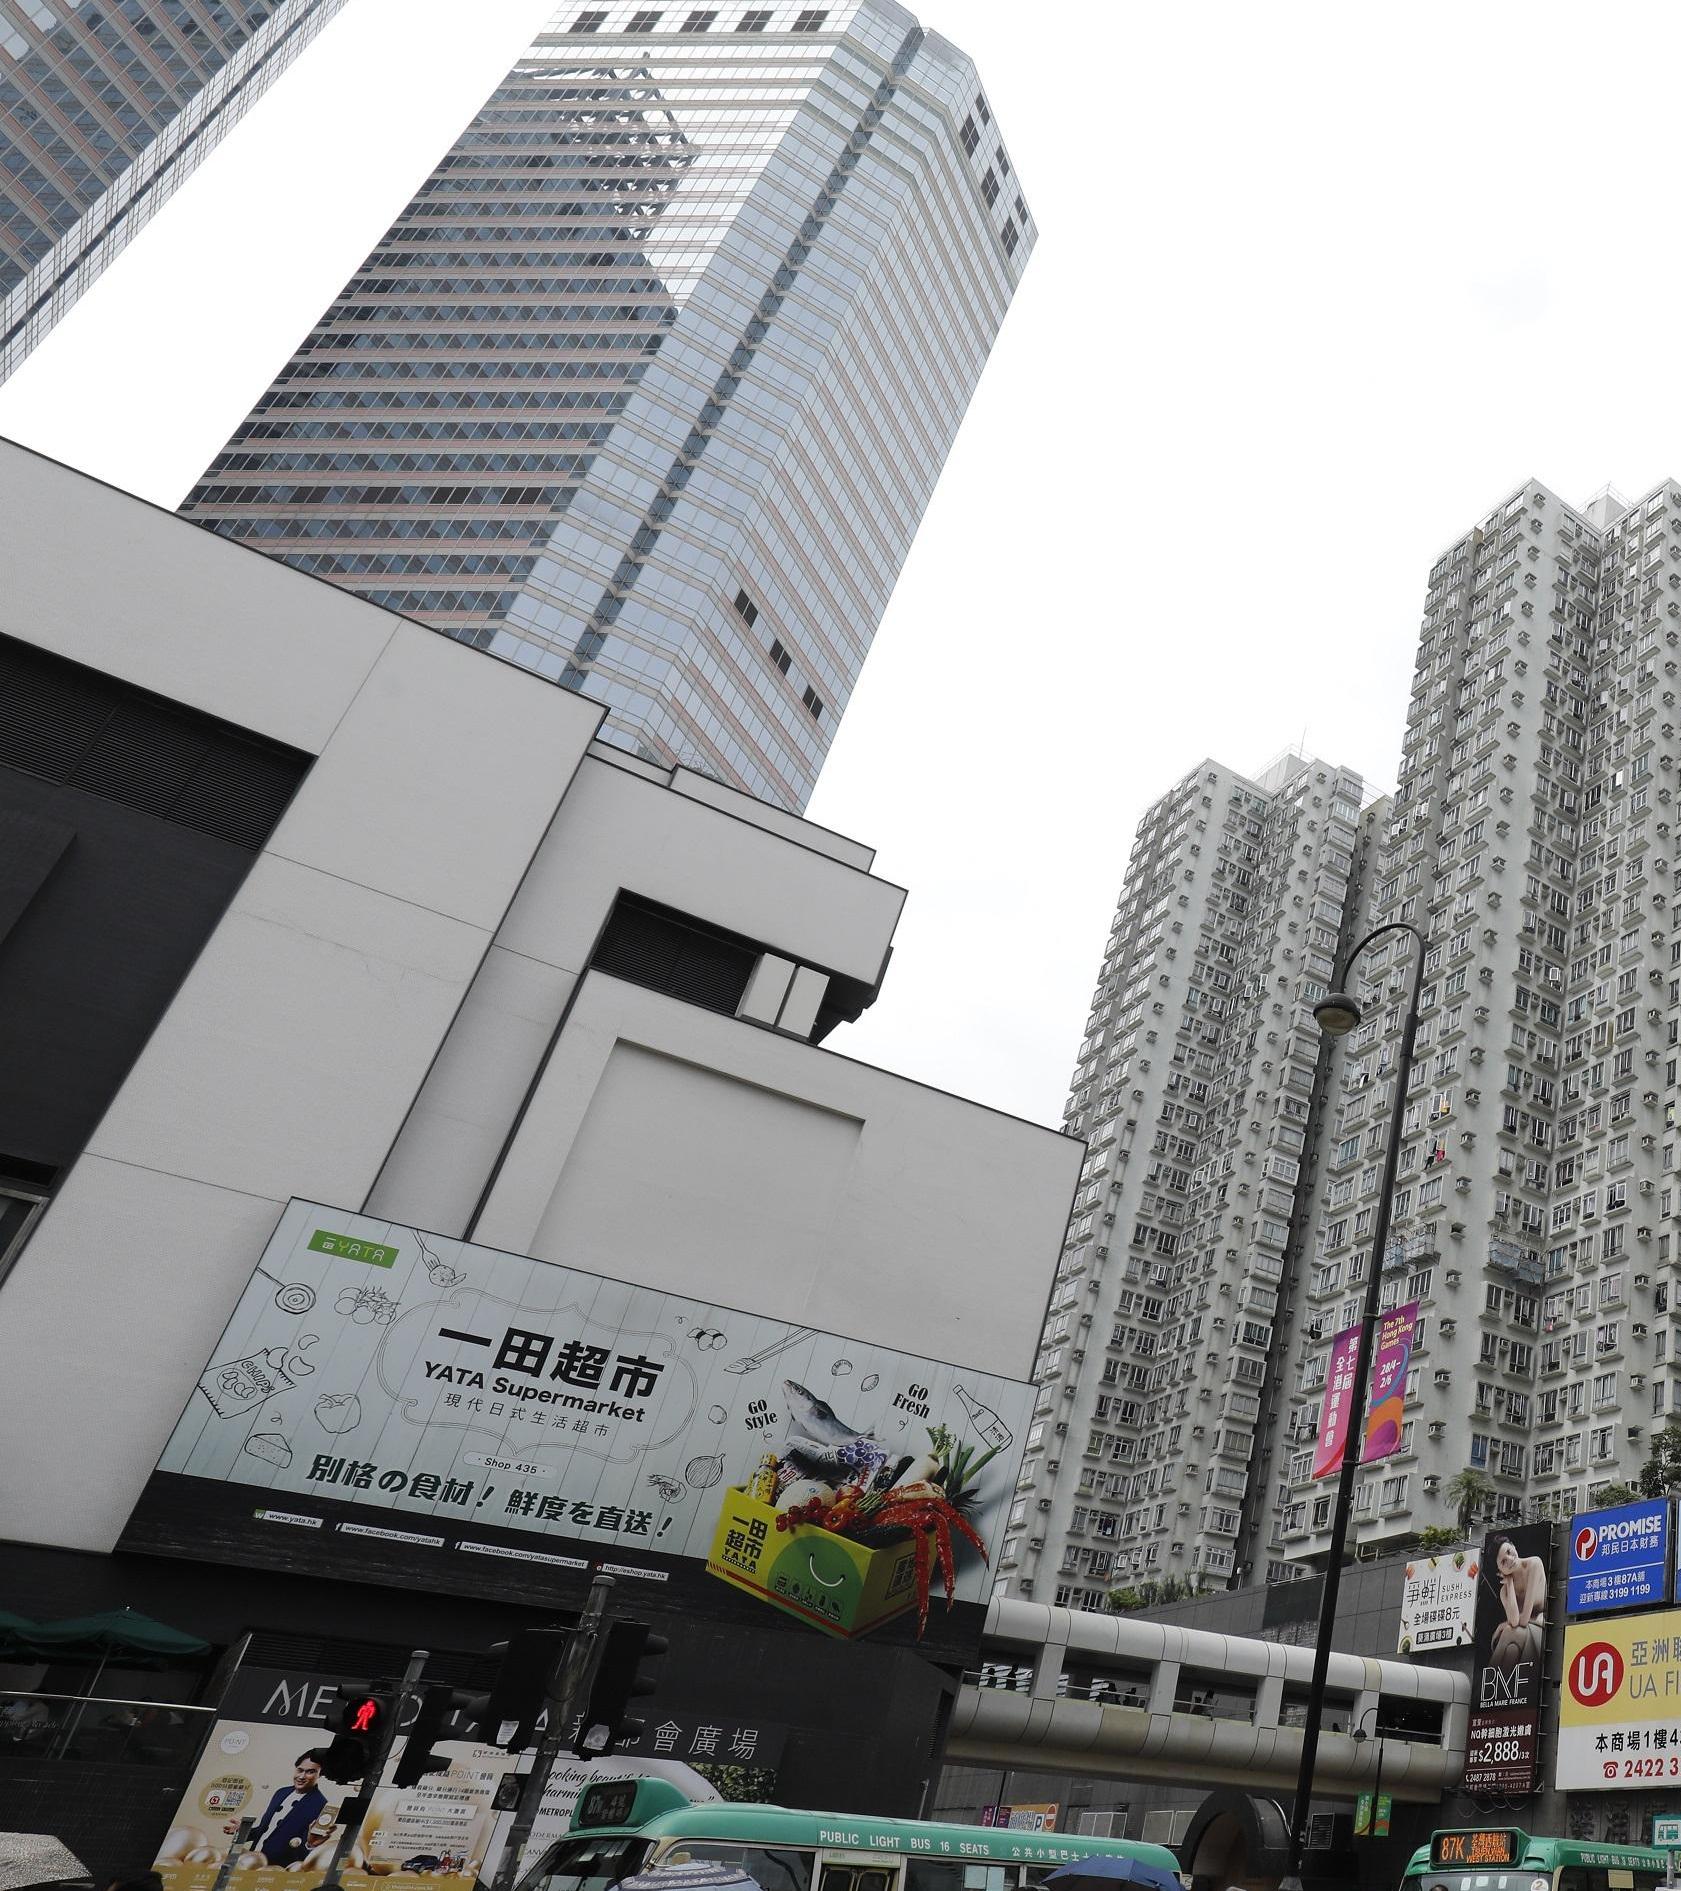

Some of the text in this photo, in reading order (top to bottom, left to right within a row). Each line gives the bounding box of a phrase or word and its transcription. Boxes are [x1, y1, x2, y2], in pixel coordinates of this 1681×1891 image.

[1382, 1323, 1413, 1341] Hong Kong
[1380, 1337, 1399, 1350] Games
[438, 1327, 664, 1398] 一田超市
[425, 1361, 645, 1422] YATA Supermarket
[908, 1383, 928, 1400] GO
[444, 1392, 609, 1437] 現代日式生活超市
[748, 1399, 767, 1415] GO
[892, 1392, 930, 1419] Fresh
[745, 1411, 777, 1431] Style
[485, 1457, 537, 1474] Shop 435
[268, 1512, 317, 1527] www.yata.hk
[1599, 1515, 1662, 1542] PROMISE
[1601, 1535, 1658, 1557] 邦民日本財務
[724, 1548, 756, 1569] YATA
[1441, 1590, 1472, 1603] EXPRESS
[1442, 1583, 1463, 1593] SUSHI
[1609, 1586, 1629, 1599] 3199
[1630, 1584, 1650, 1596] 1199
[1630, 1674, 1658, 1699] UA
[550, 1768, 586, 1787] ooking
[1624, 1758, 1664, 1778] 2422
[537, 1807, 573, 1817] METROPL
[820, 1830, 859, 1845] PUBLIC
[870, 1835, 900, 1849] LIGHT
[911, 1837, 931, 1850] BUS
[941, 1840, 950, 1852] 16
[959, 1842, 989, 1856] SEATS
[1441, 1836, 1465, 1860] 87K
